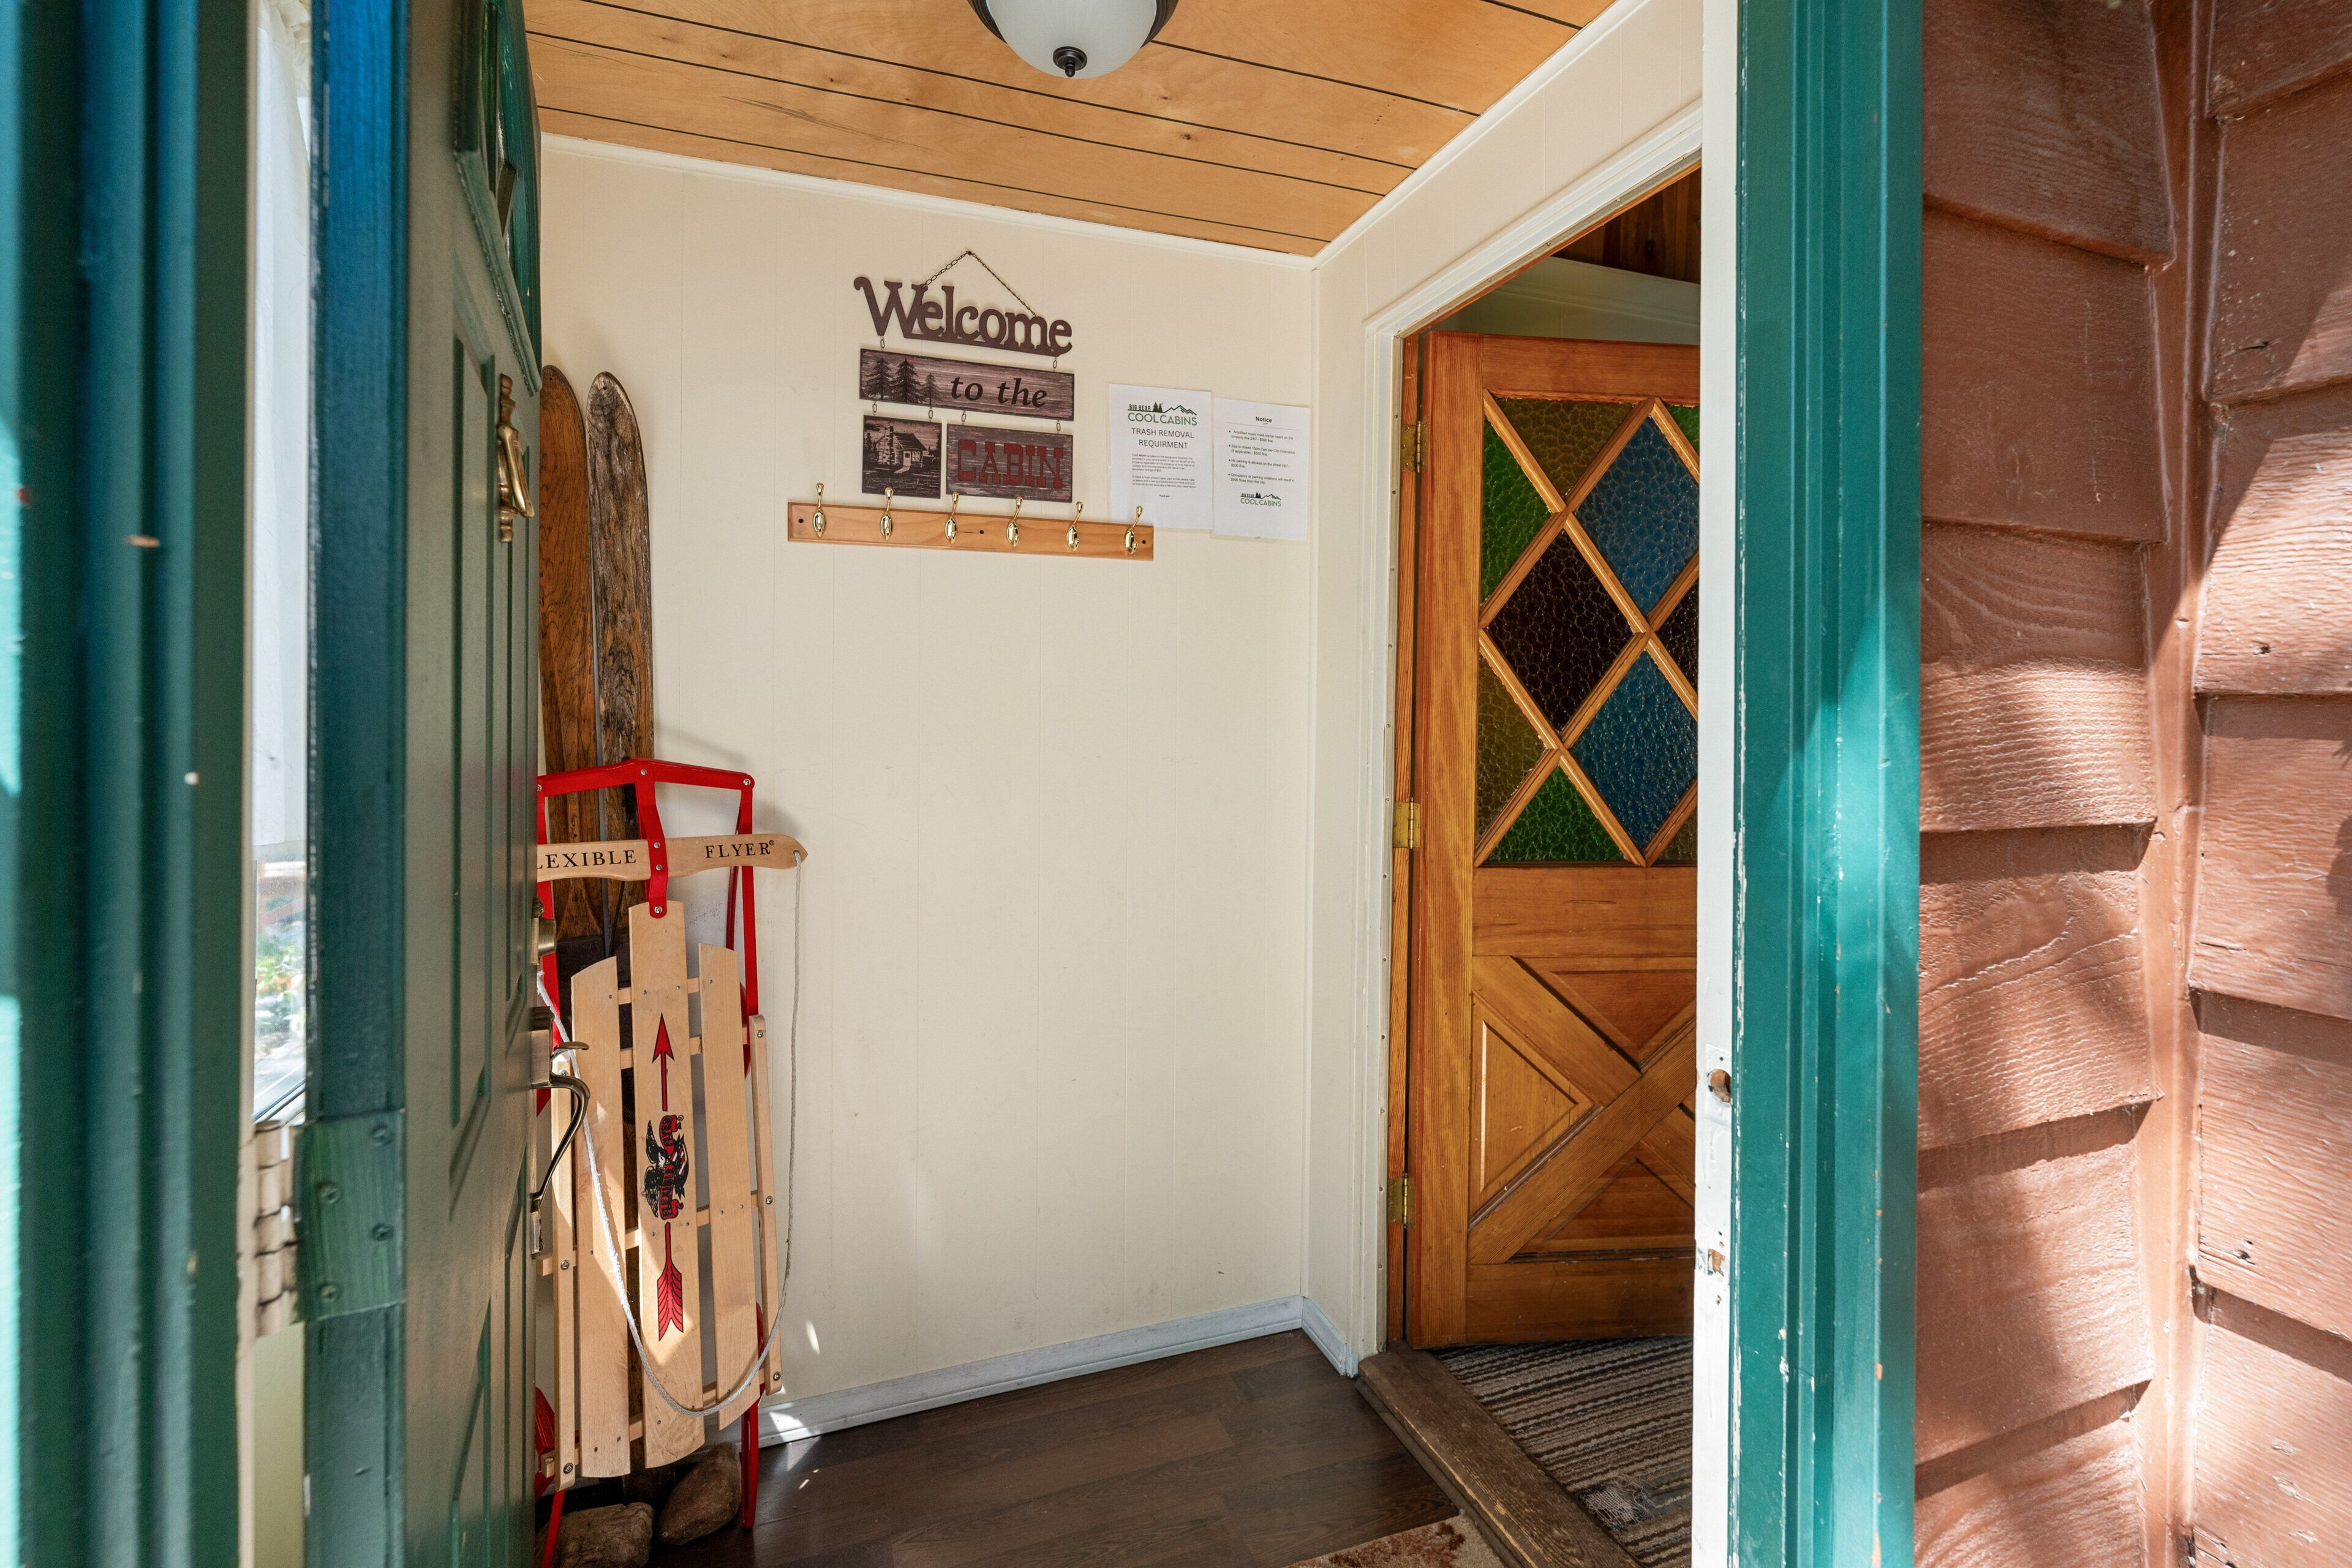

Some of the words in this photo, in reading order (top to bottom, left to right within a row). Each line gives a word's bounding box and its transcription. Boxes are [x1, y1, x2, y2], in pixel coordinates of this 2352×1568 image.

[854, 276, 1072, 356] Welcome
[951, 377, 984, 401] to
[997, 377, 1047, 408] the
[1139, 439, 1188, 449] REQUIRMENT
[1158, 429, 1194, 439] REMOVAL
[957, 439, 1063, 489] CABIN
[537, 850, 636, 869] EXIBLE
